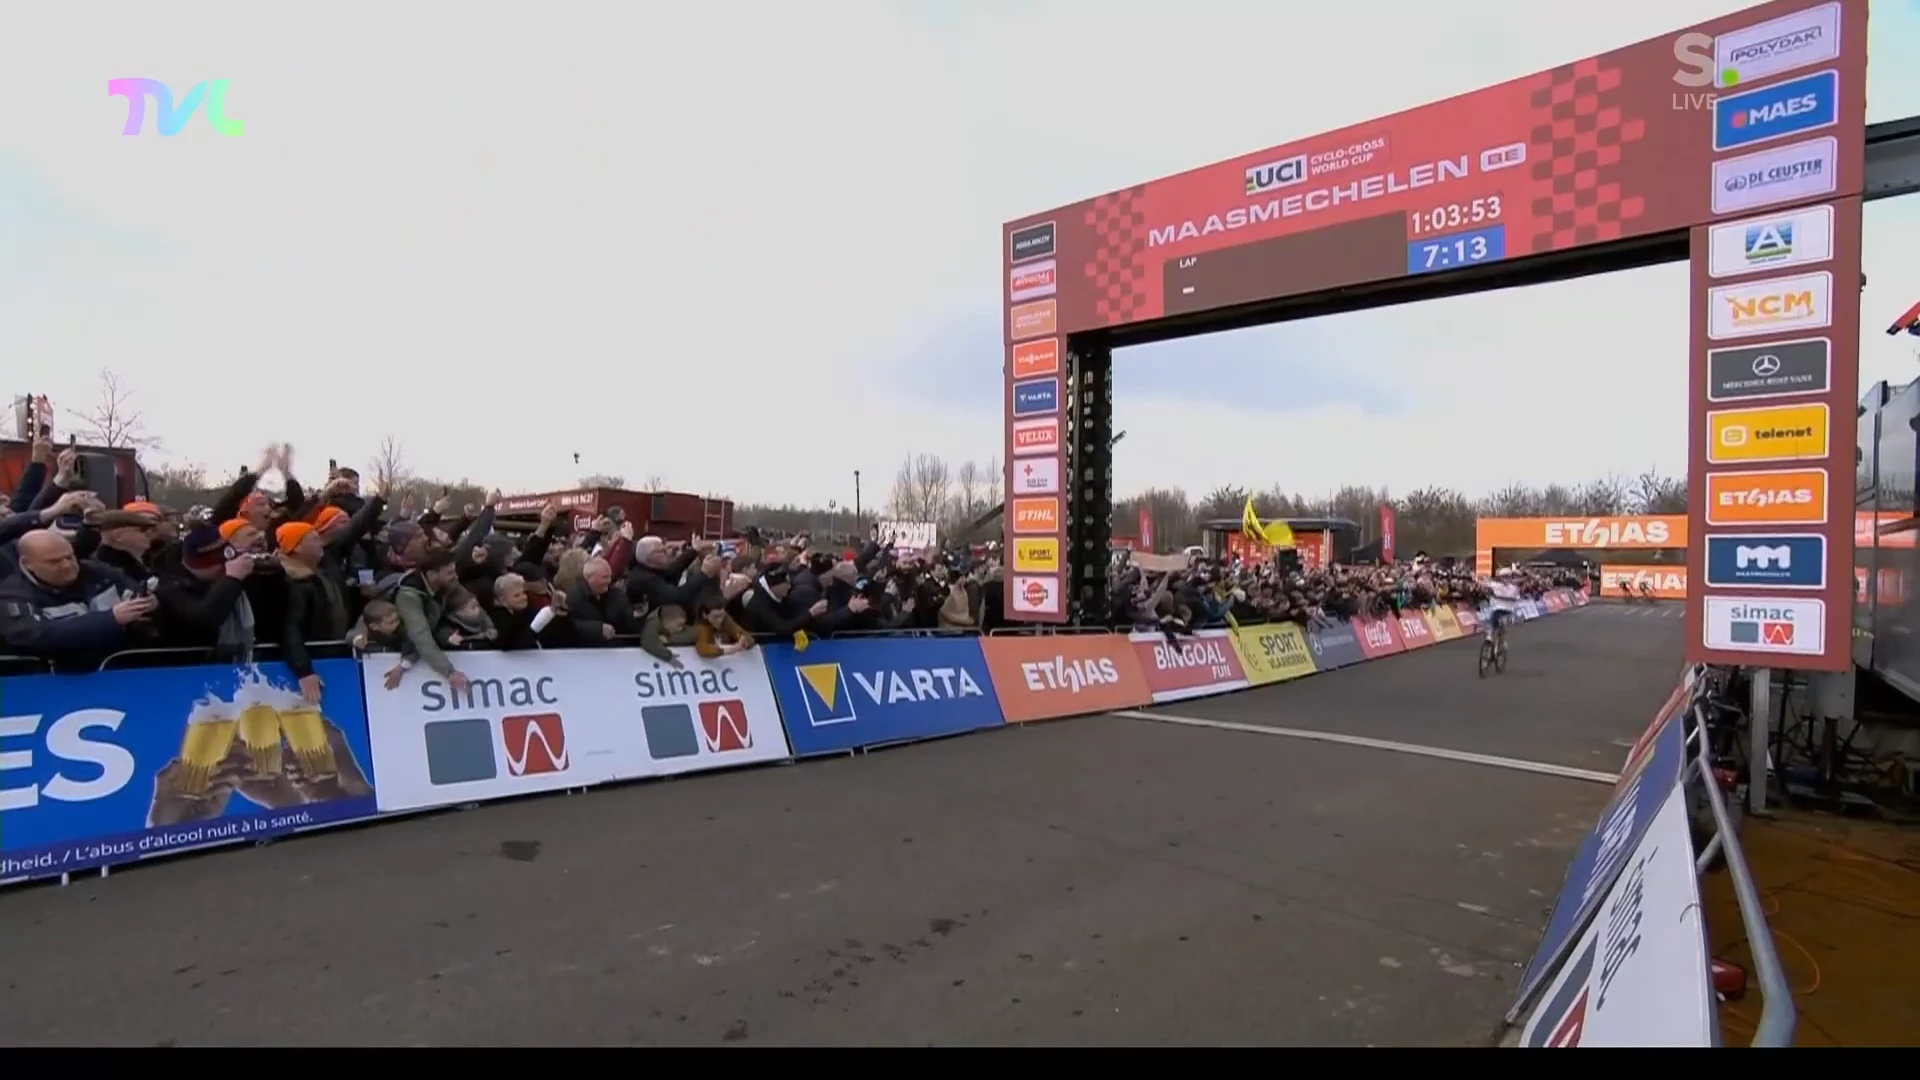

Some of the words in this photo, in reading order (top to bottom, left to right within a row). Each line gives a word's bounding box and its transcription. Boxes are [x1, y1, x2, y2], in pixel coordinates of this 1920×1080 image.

[1735, 28, 1817, 62] POLYDAK
[1749, 92, 1817, 125] MAES
[1310, 137, 1385, 165] CYCLO-CROSS
[1311, 159, 1349, 176] WORLD
[1351, 152, 1374, 166] CUP
[1255, 158, 1302, 188] UCI
[1749, 172, 1764, 184] DE
[1768, 158, 1823, 179] CEUSTER
[1148, 155, 1469, 247] MAASMECHELEN
[1412, 196, 1502, 234] 1:03:53
[1179, 256, 1197, 268] LAP
[1423, 236, 1488, 269] 7:13
[1725, 289, 1815, 320] NCM
[1027, 392, 1052, 402] VARTA
[1018, 429, 1053, 445] VELUX
[1755, 425, 1813, 440] telenet
[1017, 508, 1055, 522] STIHL
[1731, 603, 1795, 620] simac
[1154, 638, 1227, 671] BINGOAL
[634, 661, 739, 699] simac
[852, 667, 984, 706] VARTA
[1212, 663, 1231, 680] FUN
[75, 841, 135, 861] L'abus
[139, 827, 203, 849] d'alcool
[206, 822, 238, 838] nuit
[241, 819, 251, 832] à
[253, 818, 267, 831] la
[270, 810, 314, 829] santé.
